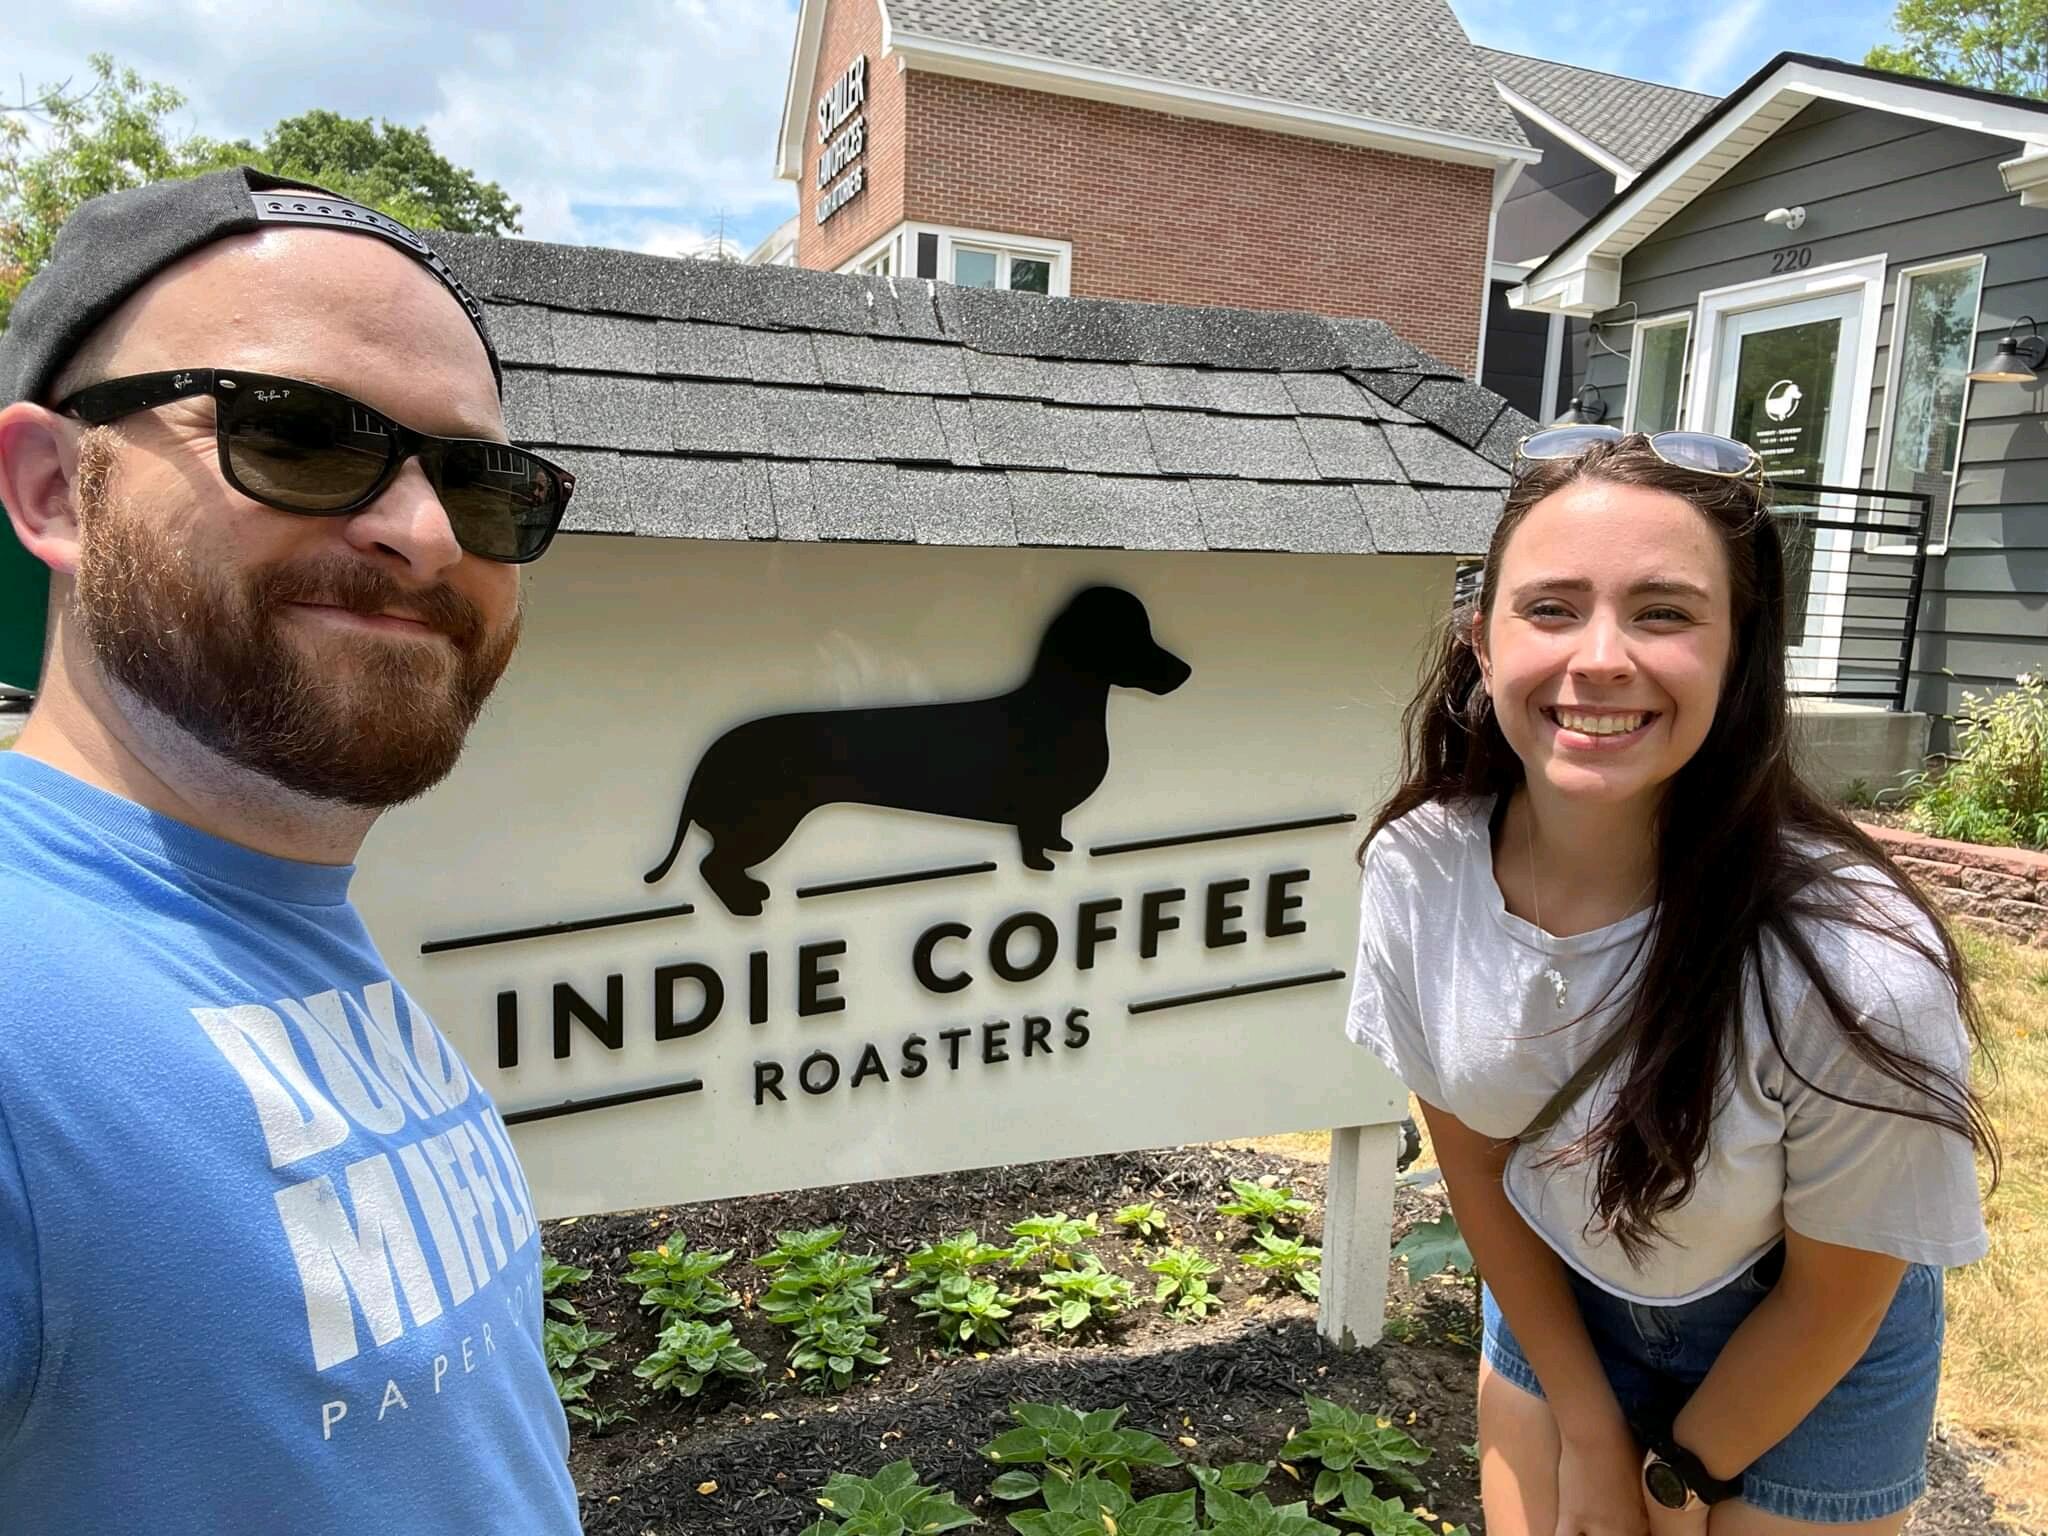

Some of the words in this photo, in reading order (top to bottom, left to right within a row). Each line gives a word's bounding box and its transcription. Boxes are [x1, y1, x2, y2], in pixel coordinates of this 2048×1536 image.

[1772, 247, 1812, 274] 220
[496, 939, 848, 1069] INDIE
[912, 868, 1312, 994] COFFEE
[190, 979, 485, 1169] DUND
[754, 1007, 1092, 1106] ROASTERS
[273, 1107, 538, 1373] MIFFLI
[321, 1321, 496, 1441] PAPER
